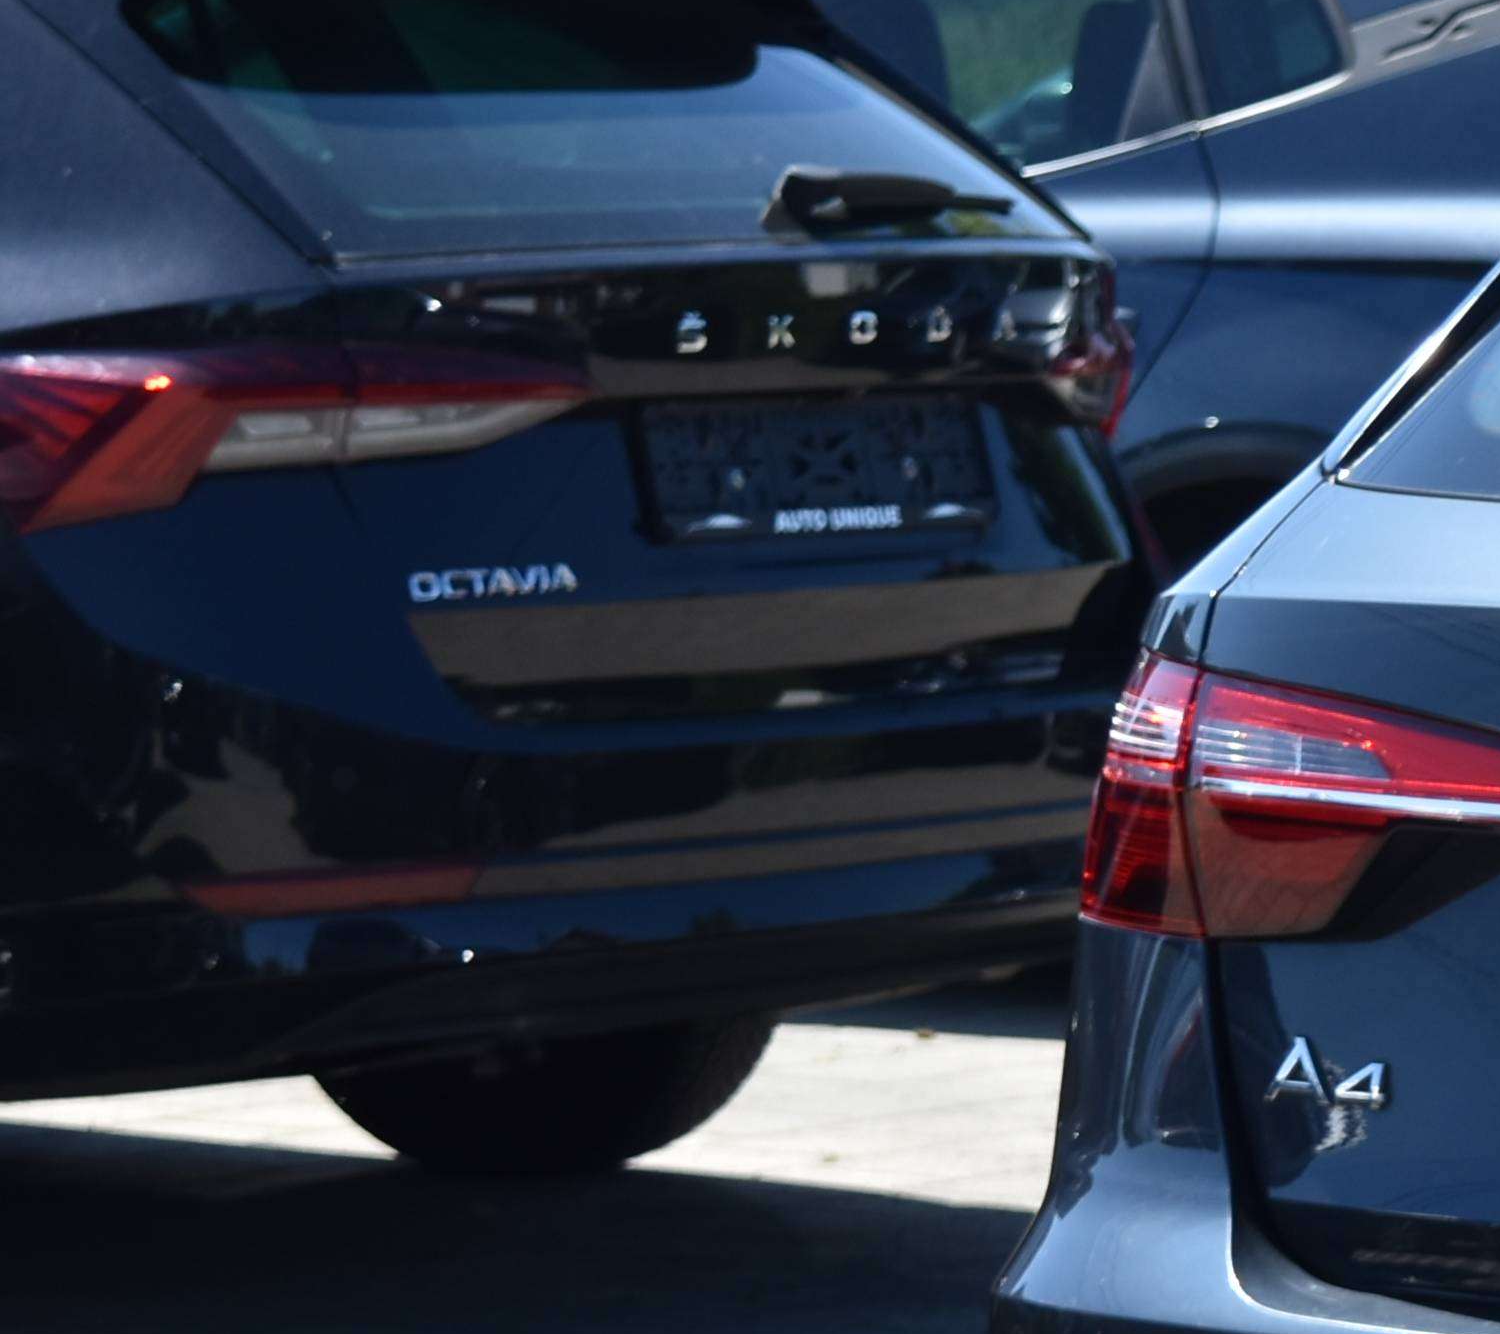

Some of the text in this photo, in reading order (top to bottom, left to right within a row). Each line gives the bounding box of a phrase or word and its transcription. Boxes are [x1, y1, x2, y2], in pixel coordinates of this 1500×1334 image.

[774, 505, 902, 533] AUTO UNIQUE
[409, 561, 578, 602] OCTAVIA
[1263, 1036, 1385, 1109] A4
